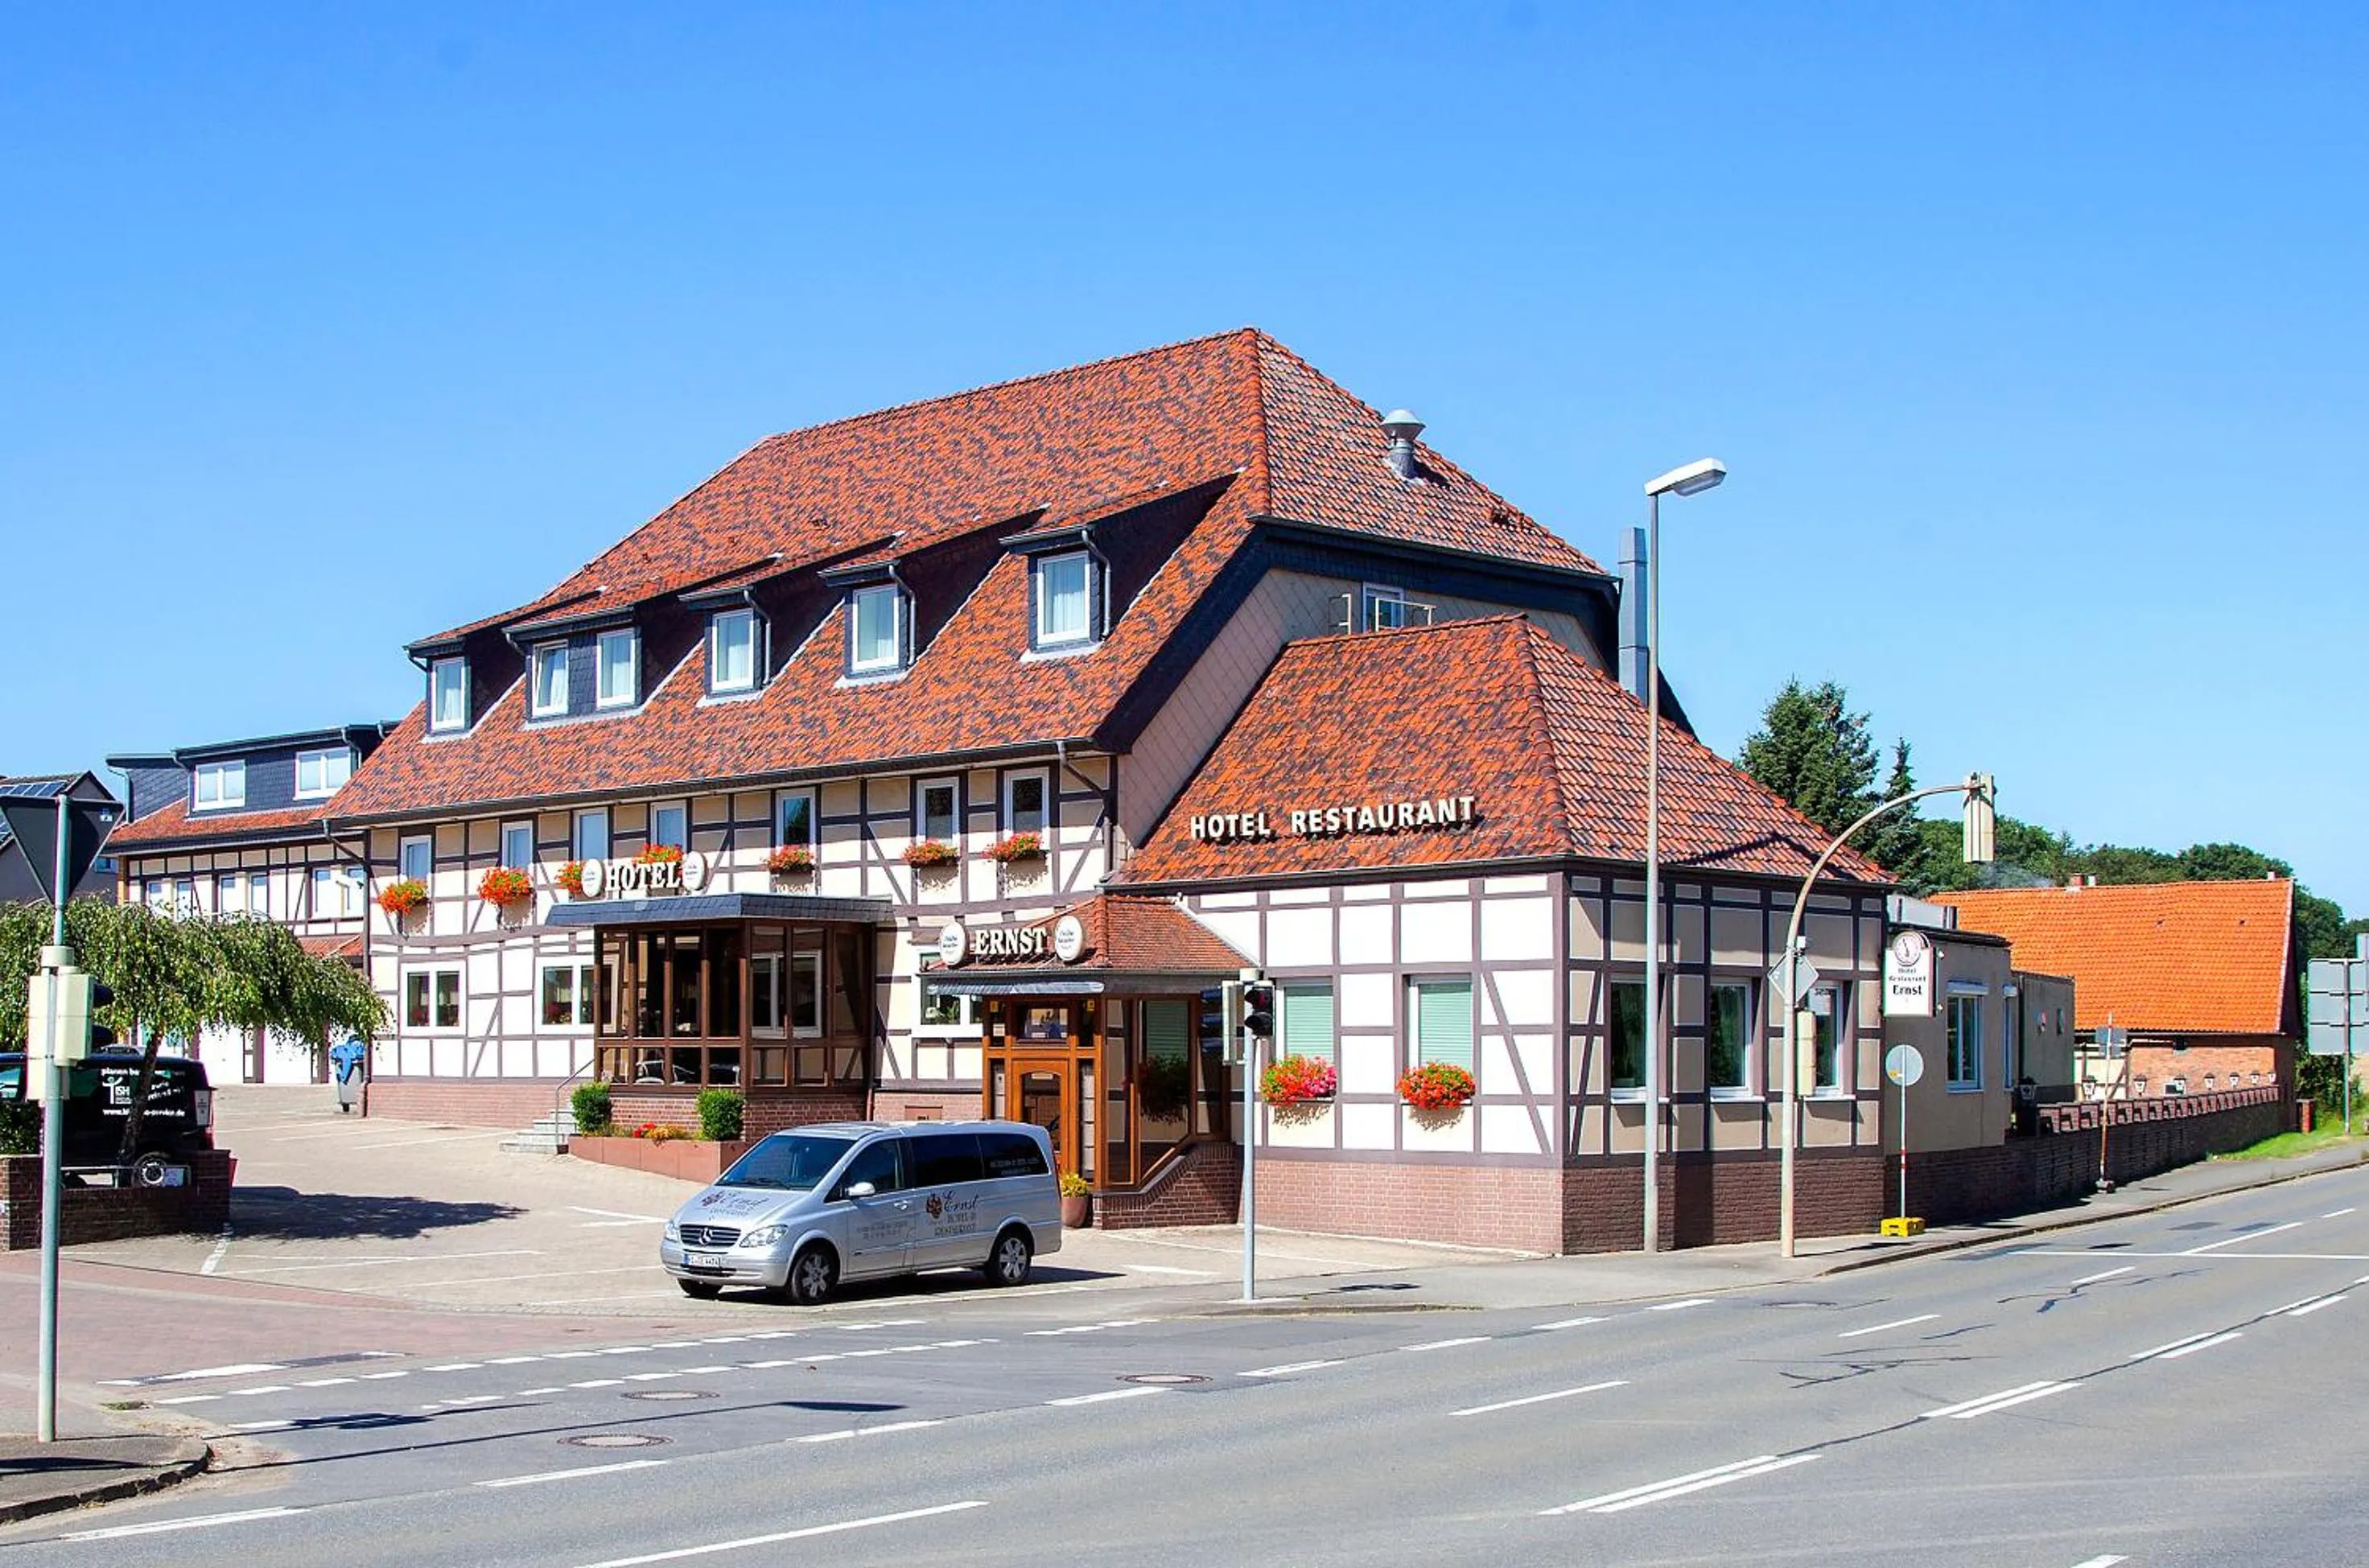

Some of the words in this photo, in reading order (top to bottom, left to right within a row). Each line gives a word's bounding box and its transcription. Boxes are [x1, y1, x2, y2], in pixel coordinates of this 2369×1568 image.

[1190, 813, 1271, 838] HOTEL
[1291, 795, 1476, 834] RESTAURANT
[604, 862, 682, 891] HOTEL
[974, 927, 1048, 955] ERNST
[1893, 985, 1922, 995] Ernst
